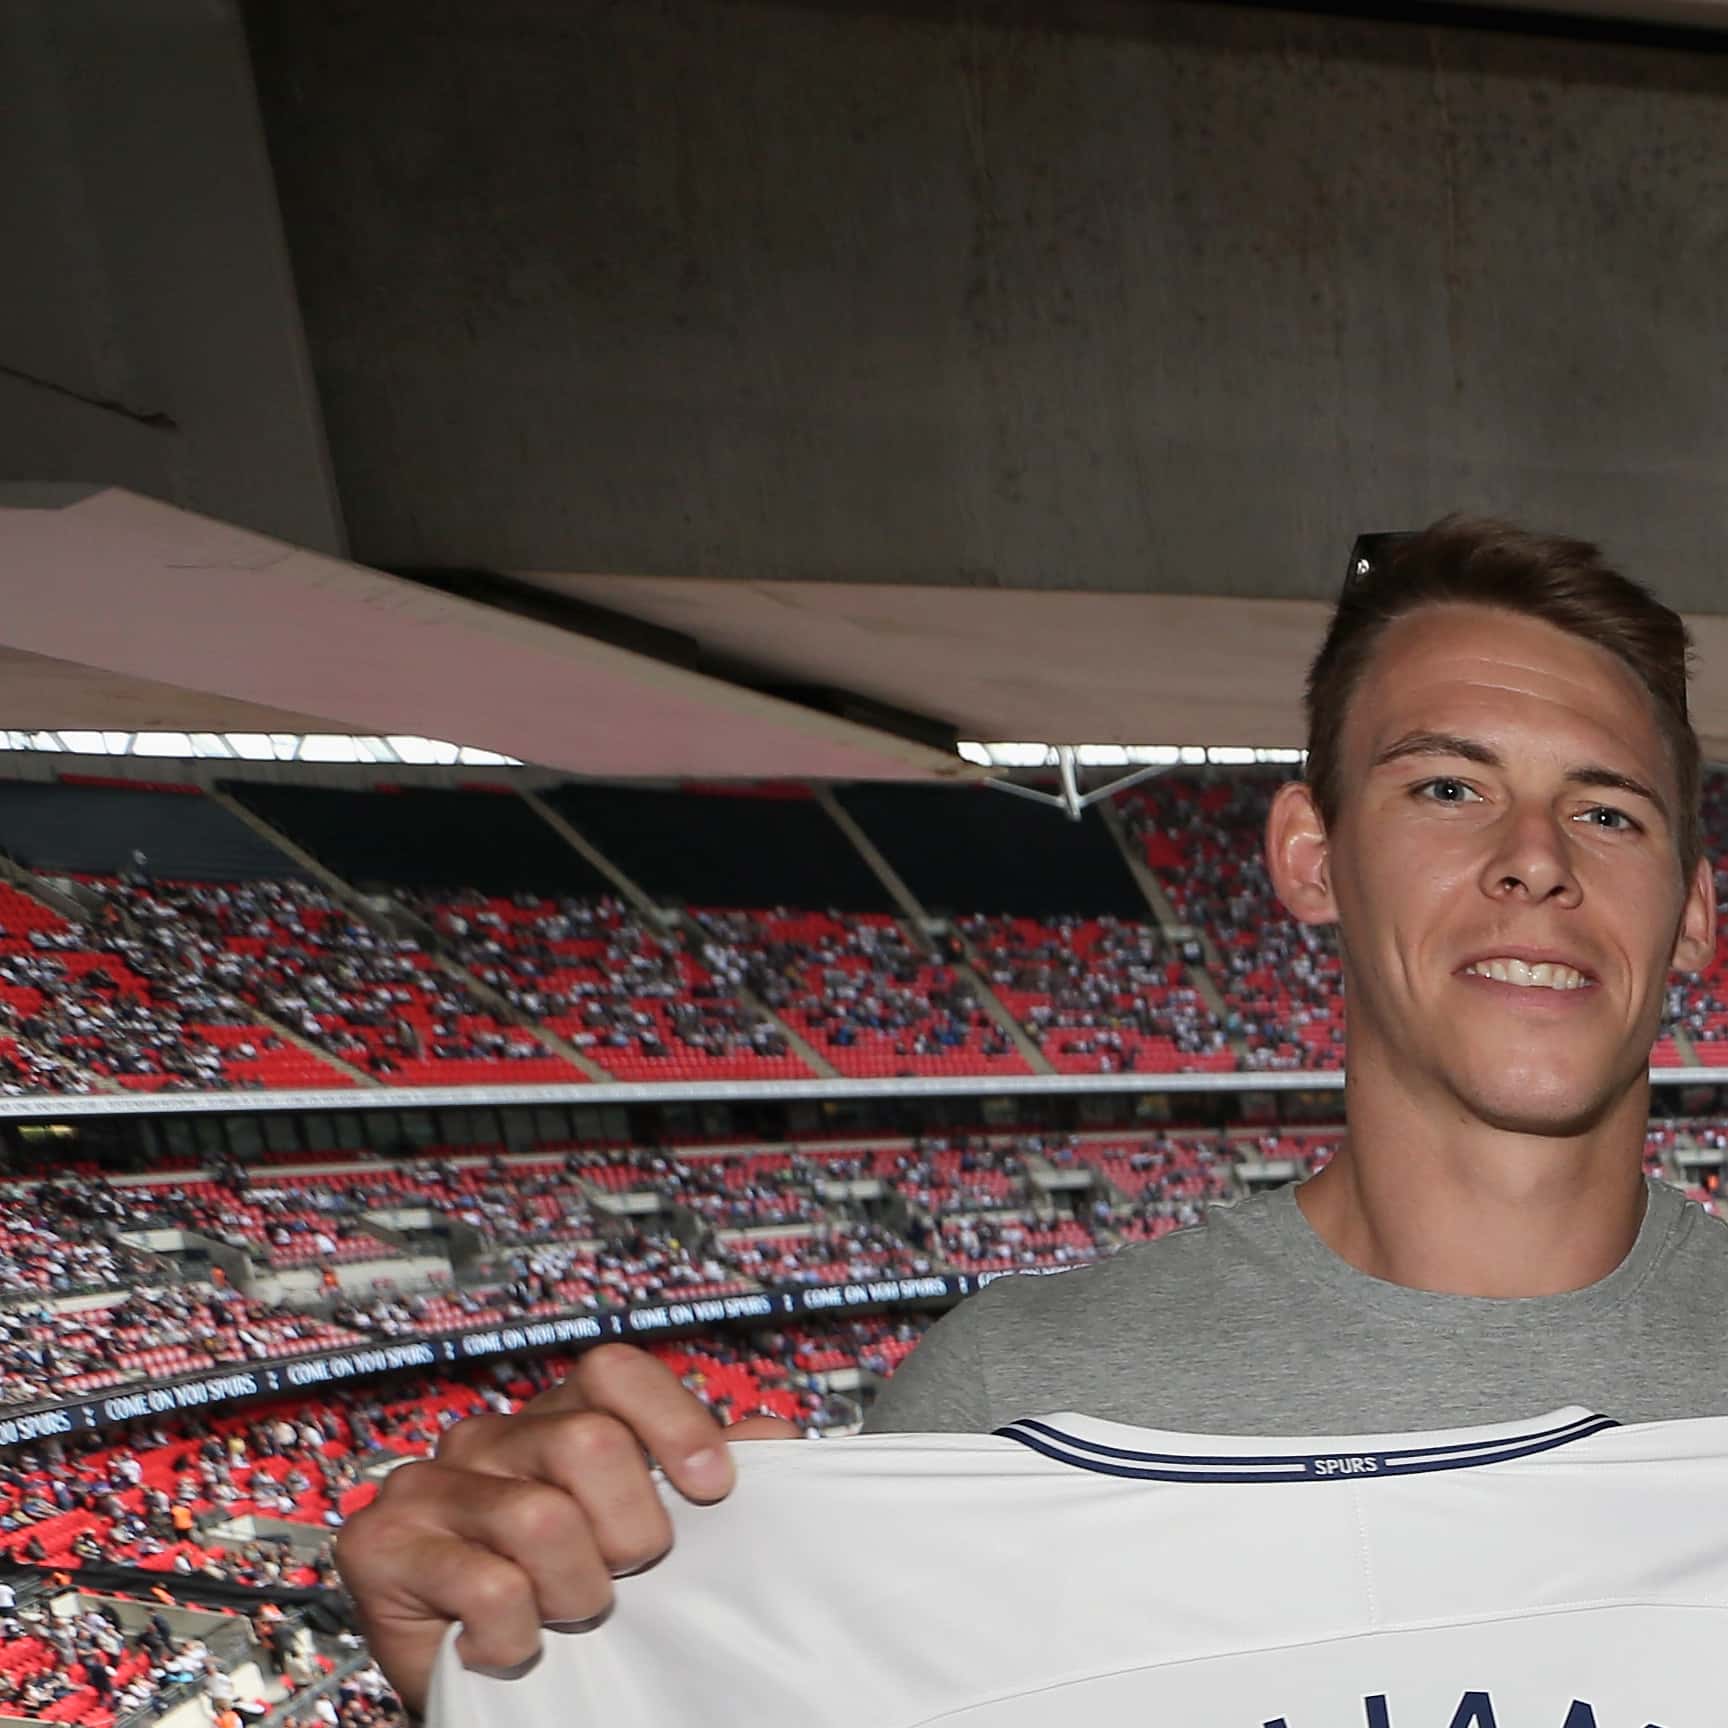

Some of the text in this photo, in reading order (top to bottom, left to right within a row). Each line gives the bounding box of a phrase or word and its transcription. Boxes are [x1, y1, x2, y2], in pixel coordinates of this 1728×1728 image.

[286, 1342, 434, 1385] COME ON YOU SPURS
[104, 1372, 258, 1421] COME ON YOU SPURS
[1314, 1456, 1378, 1475] SPURS
